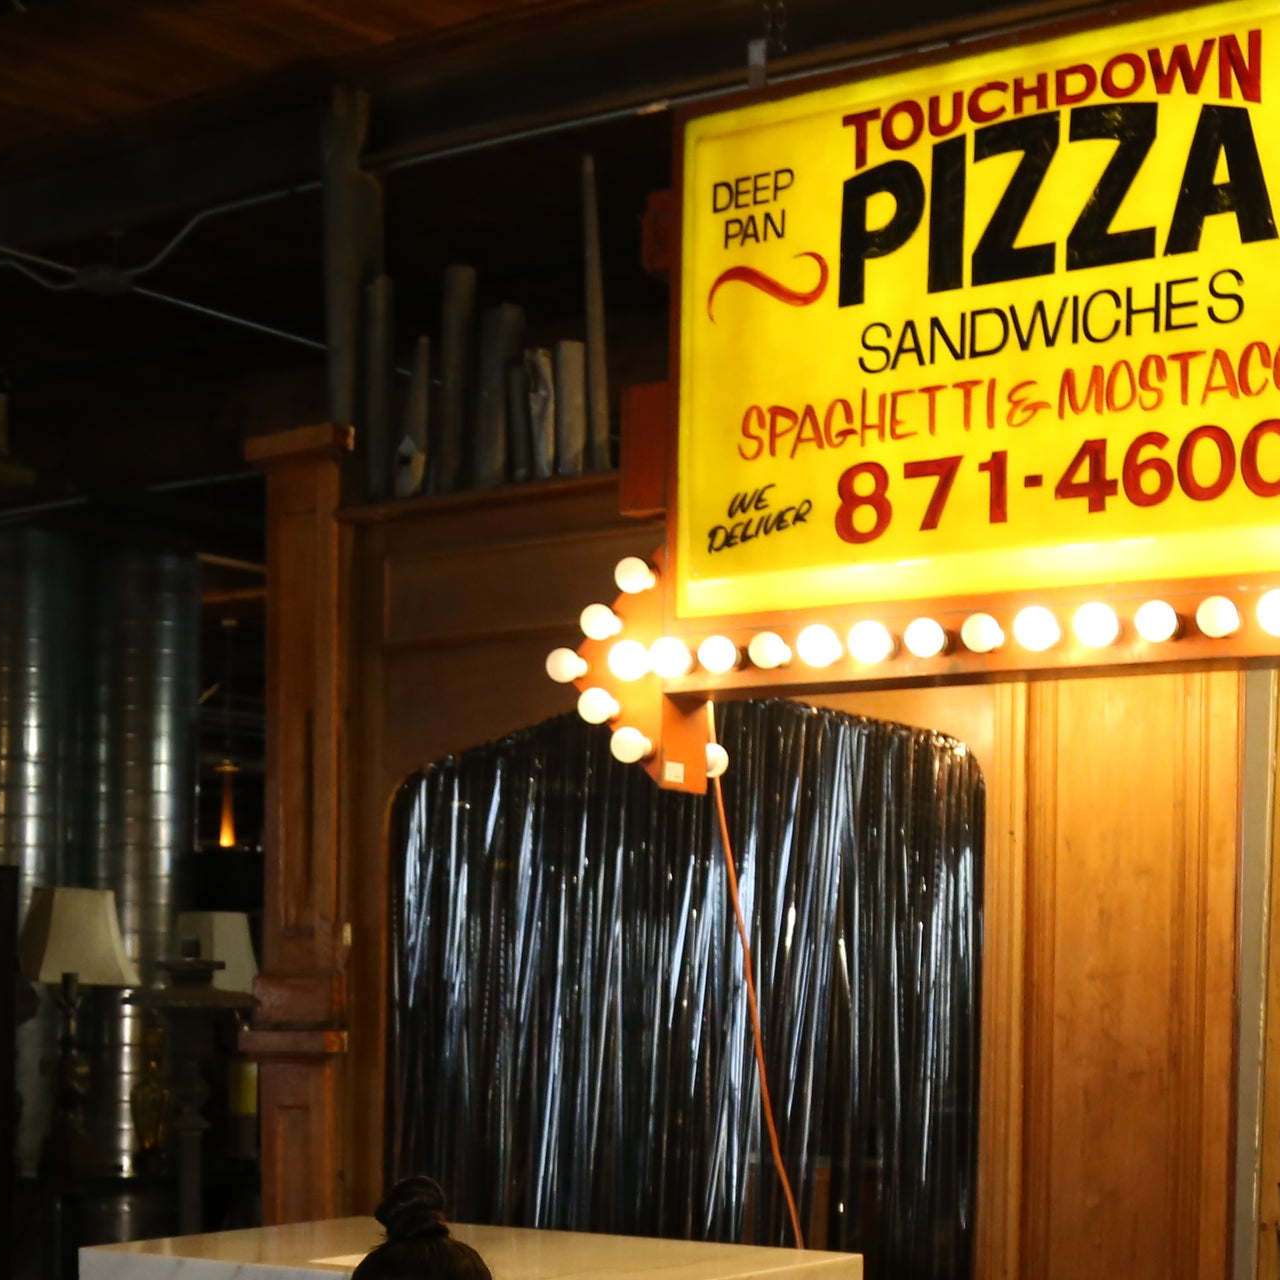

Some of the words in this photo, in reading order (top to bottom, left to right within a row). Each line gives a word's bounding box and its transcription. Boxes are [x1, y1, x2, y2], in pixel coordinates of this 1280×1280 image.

[841, 27, 1263, 172] TOUCHDOWN
[711, 167, 796, 215] DEEP
[837, 97, 1280, 309] PIZZA
[723, 208, 786, 251] PAN
[857, 268, 1245, 375] SANDWICHES
[737, 376, 997, 462] SPAGHETTI
[1006, 379, 1052, 428] &
[707, 498, 813, 555] DELIVER
[727, 483, 776, 519] WE
